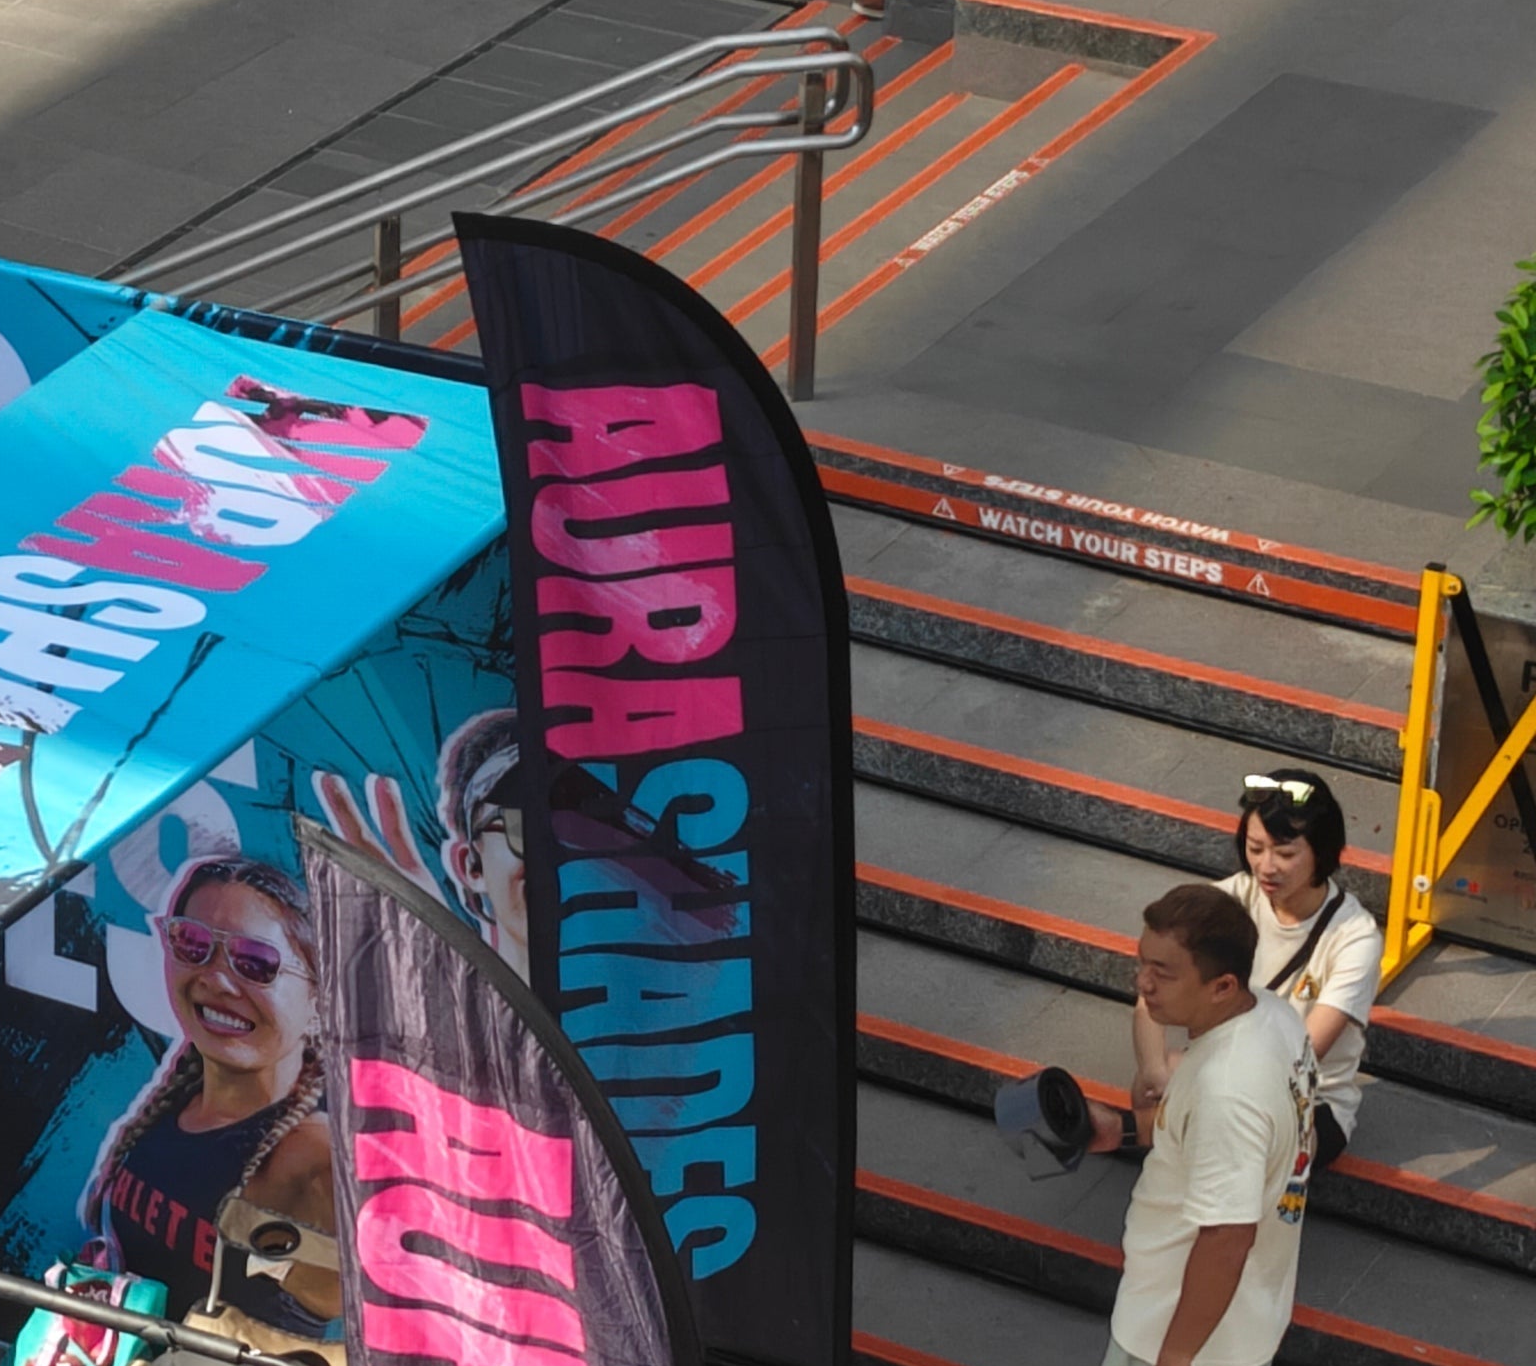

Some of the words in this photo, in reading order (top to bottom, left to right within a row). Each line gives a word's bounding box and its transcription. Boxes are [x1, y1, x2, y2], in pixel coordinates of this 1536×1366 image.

[982, 473, 1065, 502] STEPS
[1066, 492, 1136, 521] YOUR
[1139, 508, 1229, 543] WATCH
[977, 506, 1064, 549] WATCH
[1069, 528, 1137, 565] YOUR
[1143, 547, 1223, 584] STEPS
[111, 1166, 218, 1274] HLETE
